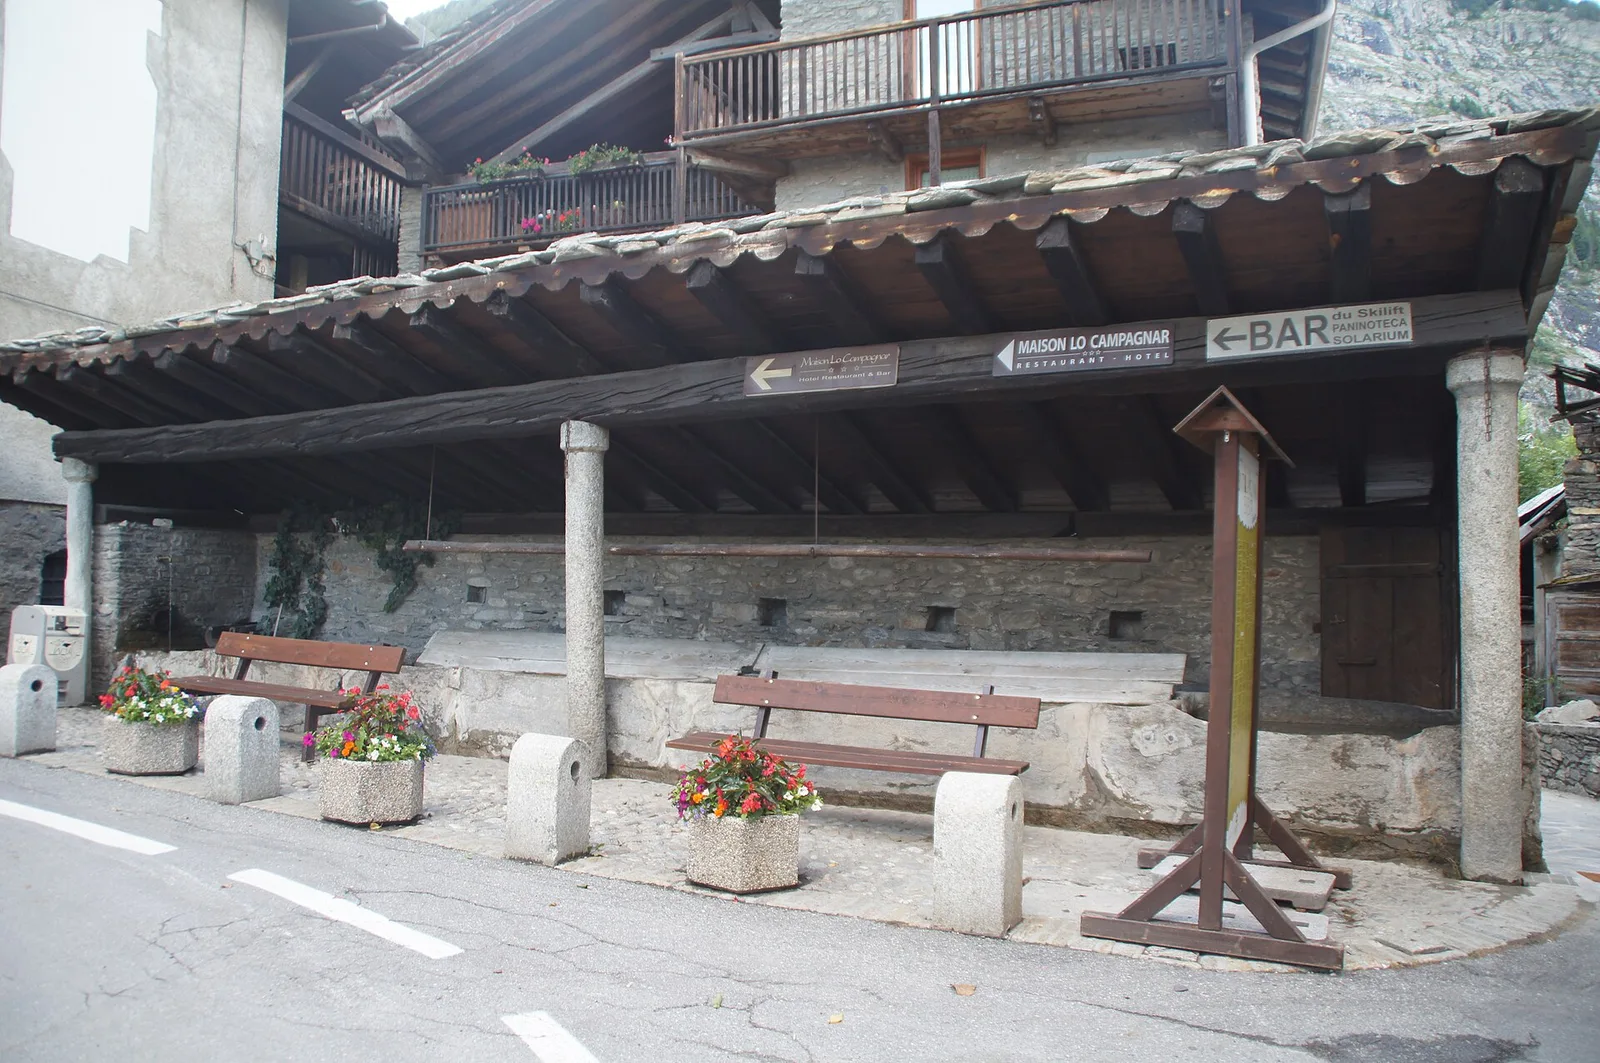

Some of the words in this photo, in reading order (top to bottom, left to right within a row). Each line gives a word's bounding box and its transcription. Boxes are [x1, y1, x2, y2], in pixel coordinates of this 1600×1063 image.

[1332, 310, 1352, 321] du
[1358, 305, 1405, 318] Skilift
[1249, 314, 1330, 351] BAR
[1332, 318, 1408, 333] PANINOTECA
[1018, 337, 1067, 354] MAISON
[1070, 335, 1087, 350] LO
[1090, 329, 1170, 349] CAMPAGNAR
[1333, 330, 1410, 345] SOLARIUM
[800, 356, 830, 369] Maison
[830, 354, 842, 365] Lo
[842, 352, 891, 364] Campagnar
[1016, 356, 1105, 369] RESTAURANT
[1125, 352, 1170, 362] HOTEL
[821, 373, 866, 381] Restaurant
